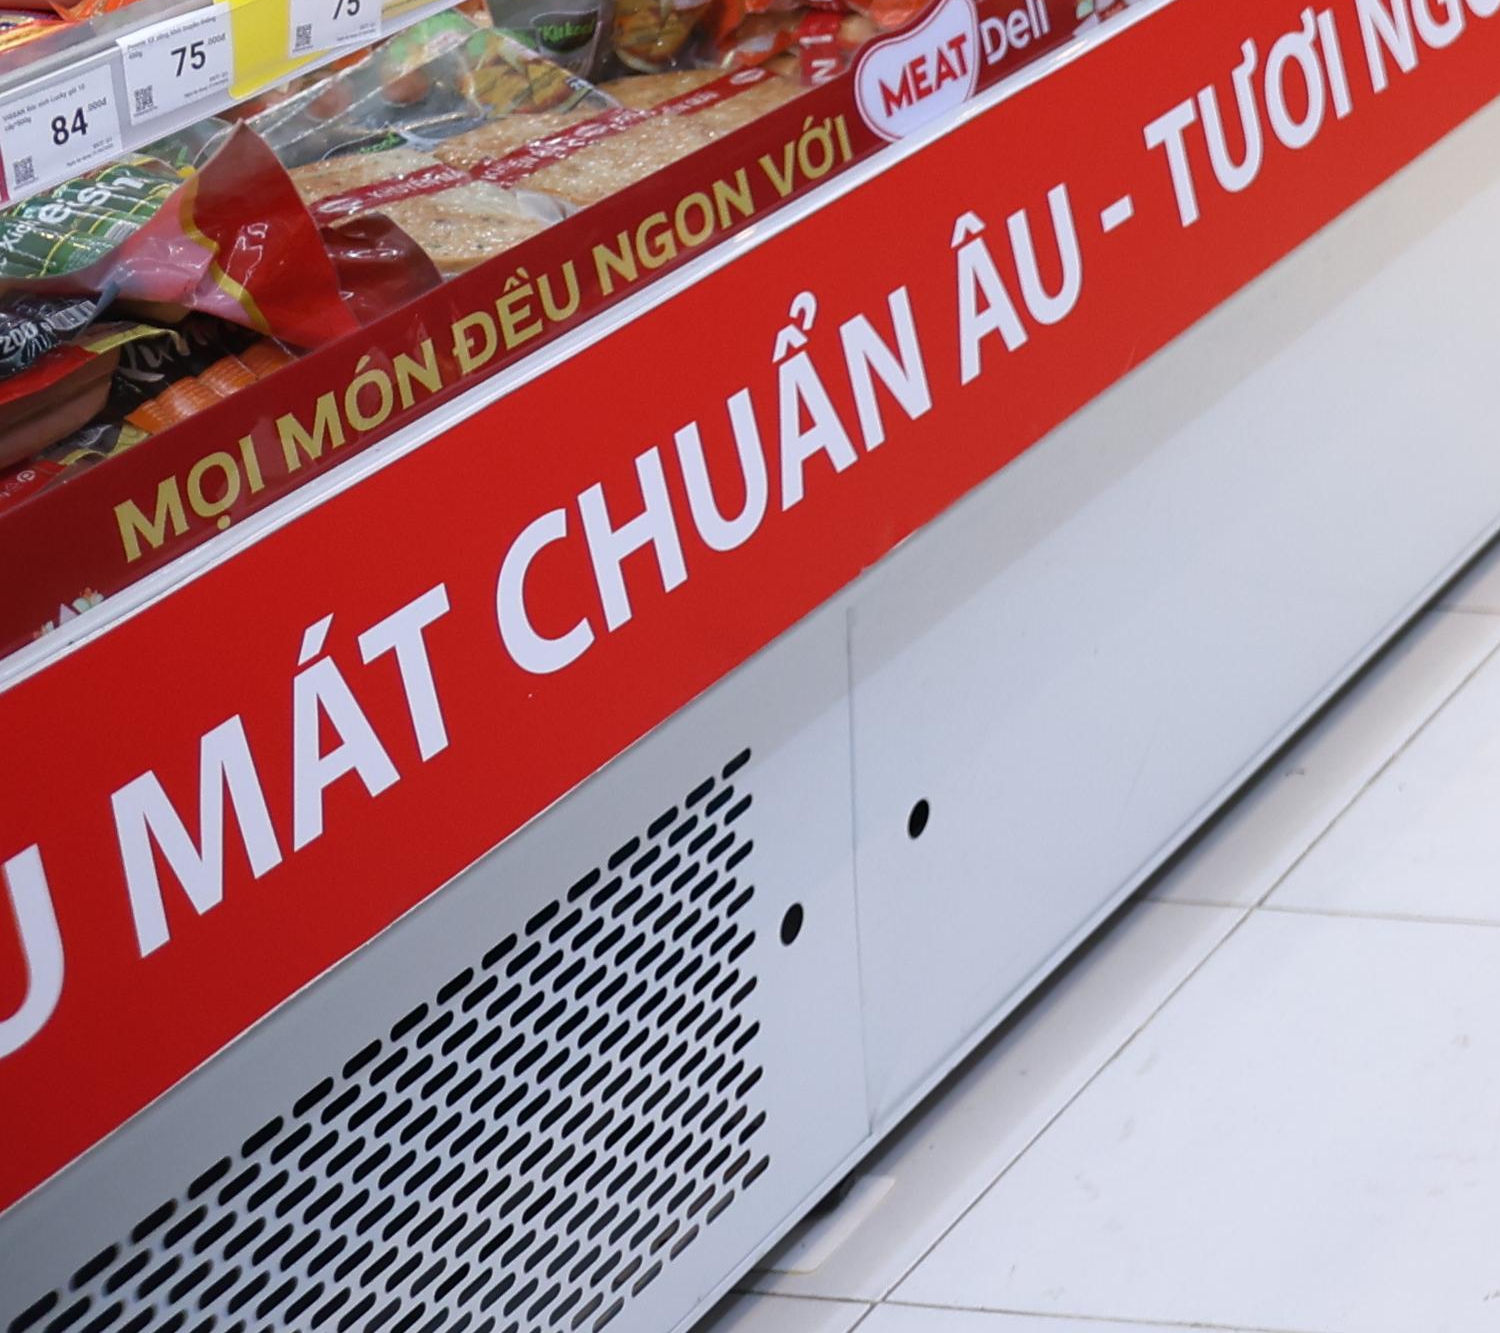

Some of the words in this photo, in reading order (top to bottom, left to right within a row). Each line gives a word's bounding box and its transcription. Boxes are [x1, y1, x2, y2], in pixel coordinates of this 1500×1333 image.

[170, 39, 208, 79] 75
[877, 32, 970, 119] MEAT
[50, 106, 90, 147] 84
[112, 436, 265, 563] MỌI
[277, 337, 444, 474] MÓN
[449, 256, 583, 376] ĐỀU
[593, 169, 755, 296] NGON
[759, 113, 855, 201] VỚI
[109, 580, 453, 961] MÁT
[495, 284, 935, 676] CHUẨN
[950, 181, 1085, 389] ÂU
[1142, 5, 1355, 231] TƯƠI
